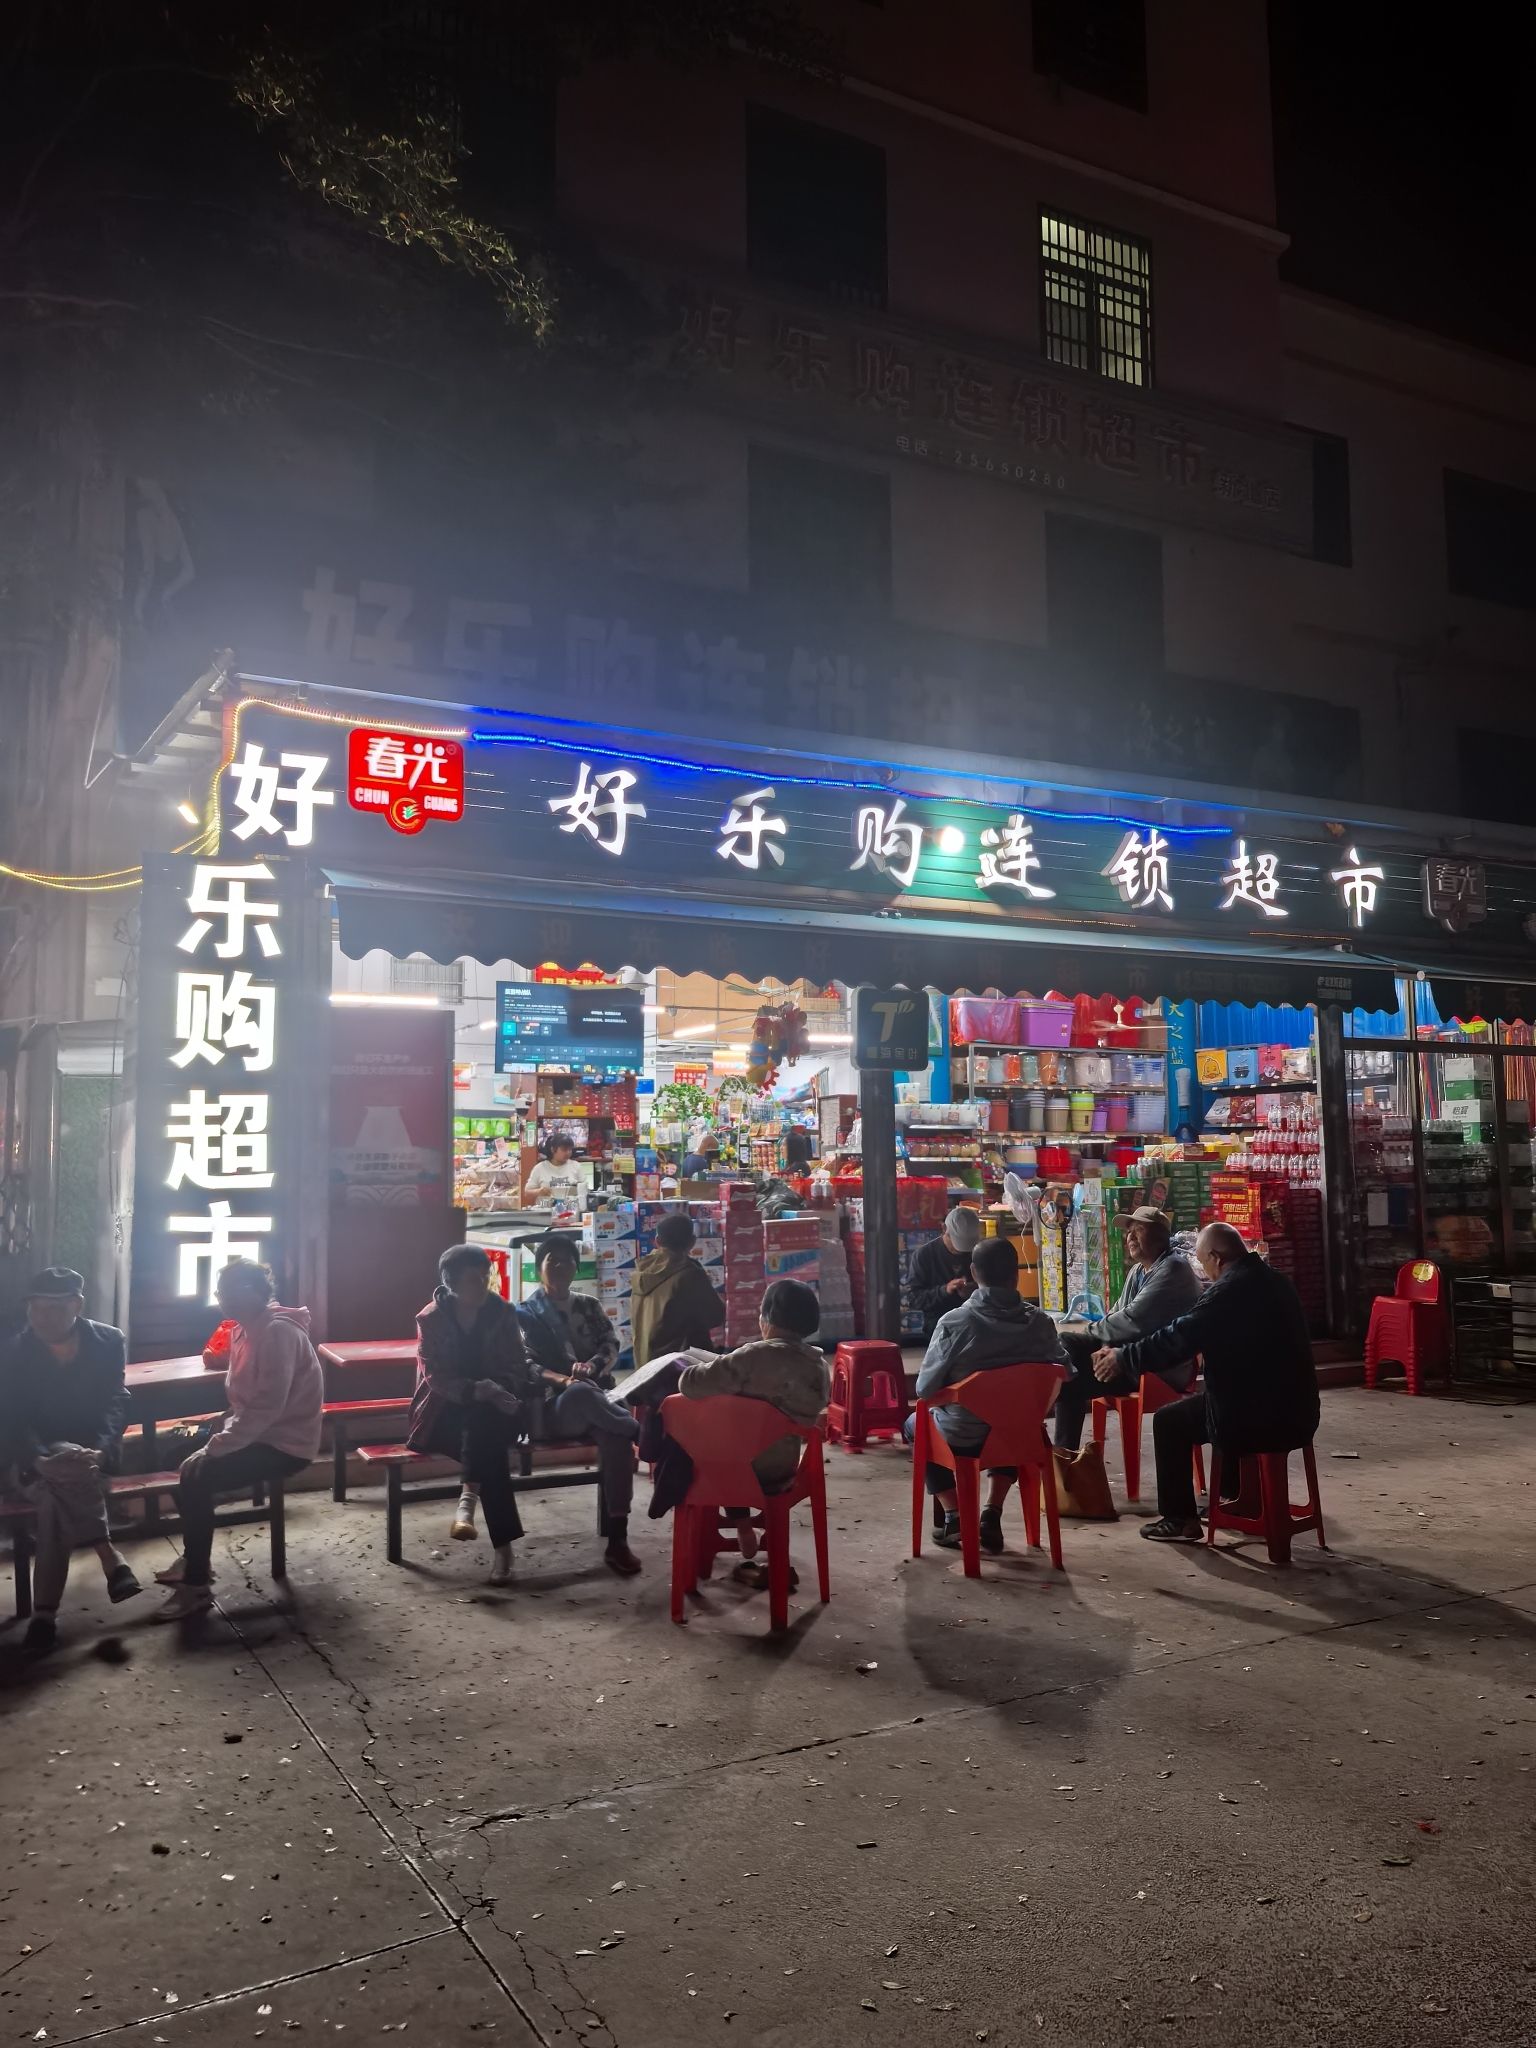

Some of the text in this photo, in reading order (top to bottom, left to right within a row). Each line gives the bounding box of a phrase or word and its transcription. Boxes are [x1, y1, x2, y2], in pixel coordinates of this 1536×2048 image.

[677, 297, 1207, 488] 好乐购连锁超市
[354, 786, 458, 813] CHUN GUANG
[363, 736, 449, 791] 春光
[548, 761, 1386, 928] 好乐购连锁超市
[165, 742, 335, 1307] 好乐购超市
